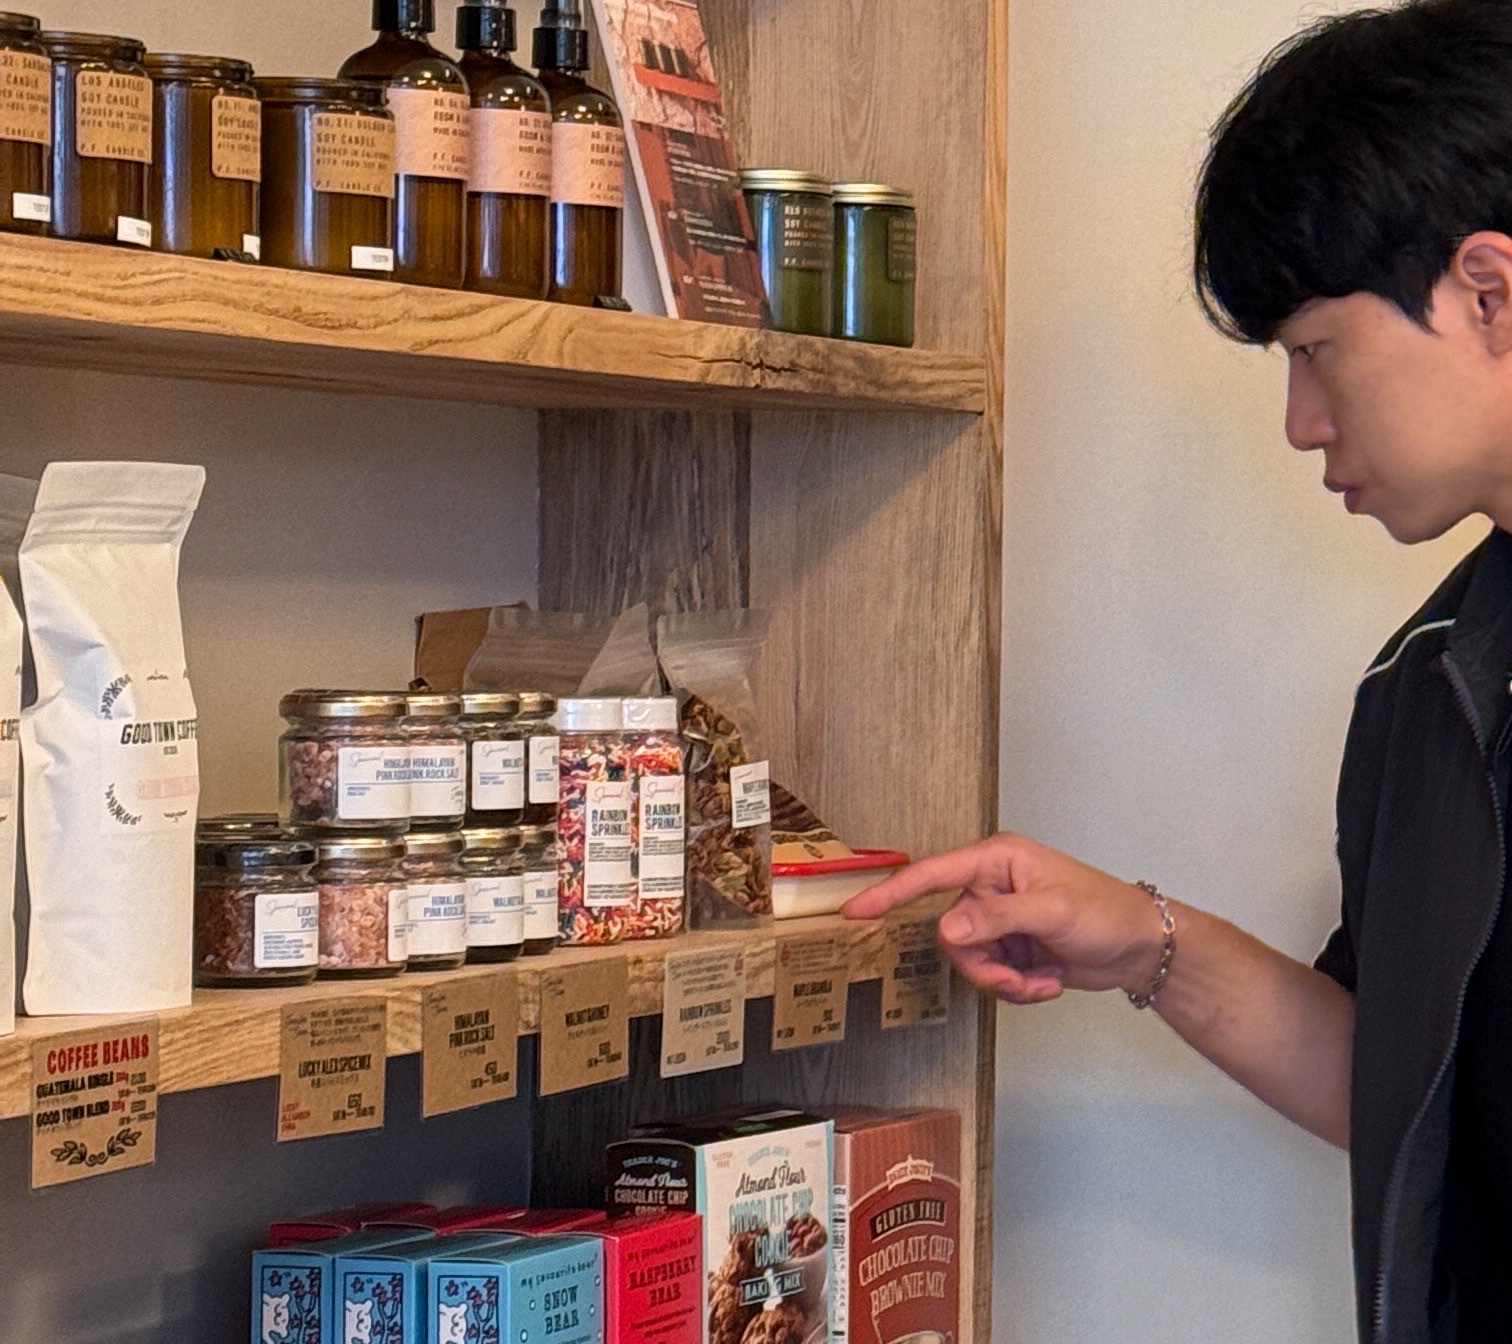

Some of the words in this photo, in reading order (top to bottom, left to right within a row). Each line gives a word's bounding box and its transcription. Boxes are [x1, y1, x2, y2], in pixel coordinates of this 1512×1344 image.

[47, 1043, 98, 1075] COFFEE
[103, 1034, 149, 1065] BEANS
[614, 1173, 657, 1187] Almond
[614, 1189, 665, 1204] CHOCOLATE
[667, 1189, 689, 1206] CHIP
[735, 1172, 777, 1198] Almond
[778, 1161, 806, 1187] Flour
[729, 1193, 788, 1236] CHOCOLATE
[875, 1200, 917, 1235] GLUTEN
[919, 1199, 943, 1221] FREE
[754, 1229, 793, 1268] COOKIE
[859, 1235, 928, 1287] CHOCOLATE
[929, 1234, 955, 1264] CHIP
[544, 1284, 578, 1312] SNOW
[869, 1270, 924, 1318] BROWNIE
[925, 1269, 948, 1299] MIX
[545, 1308, 579, 1335] BEAR
